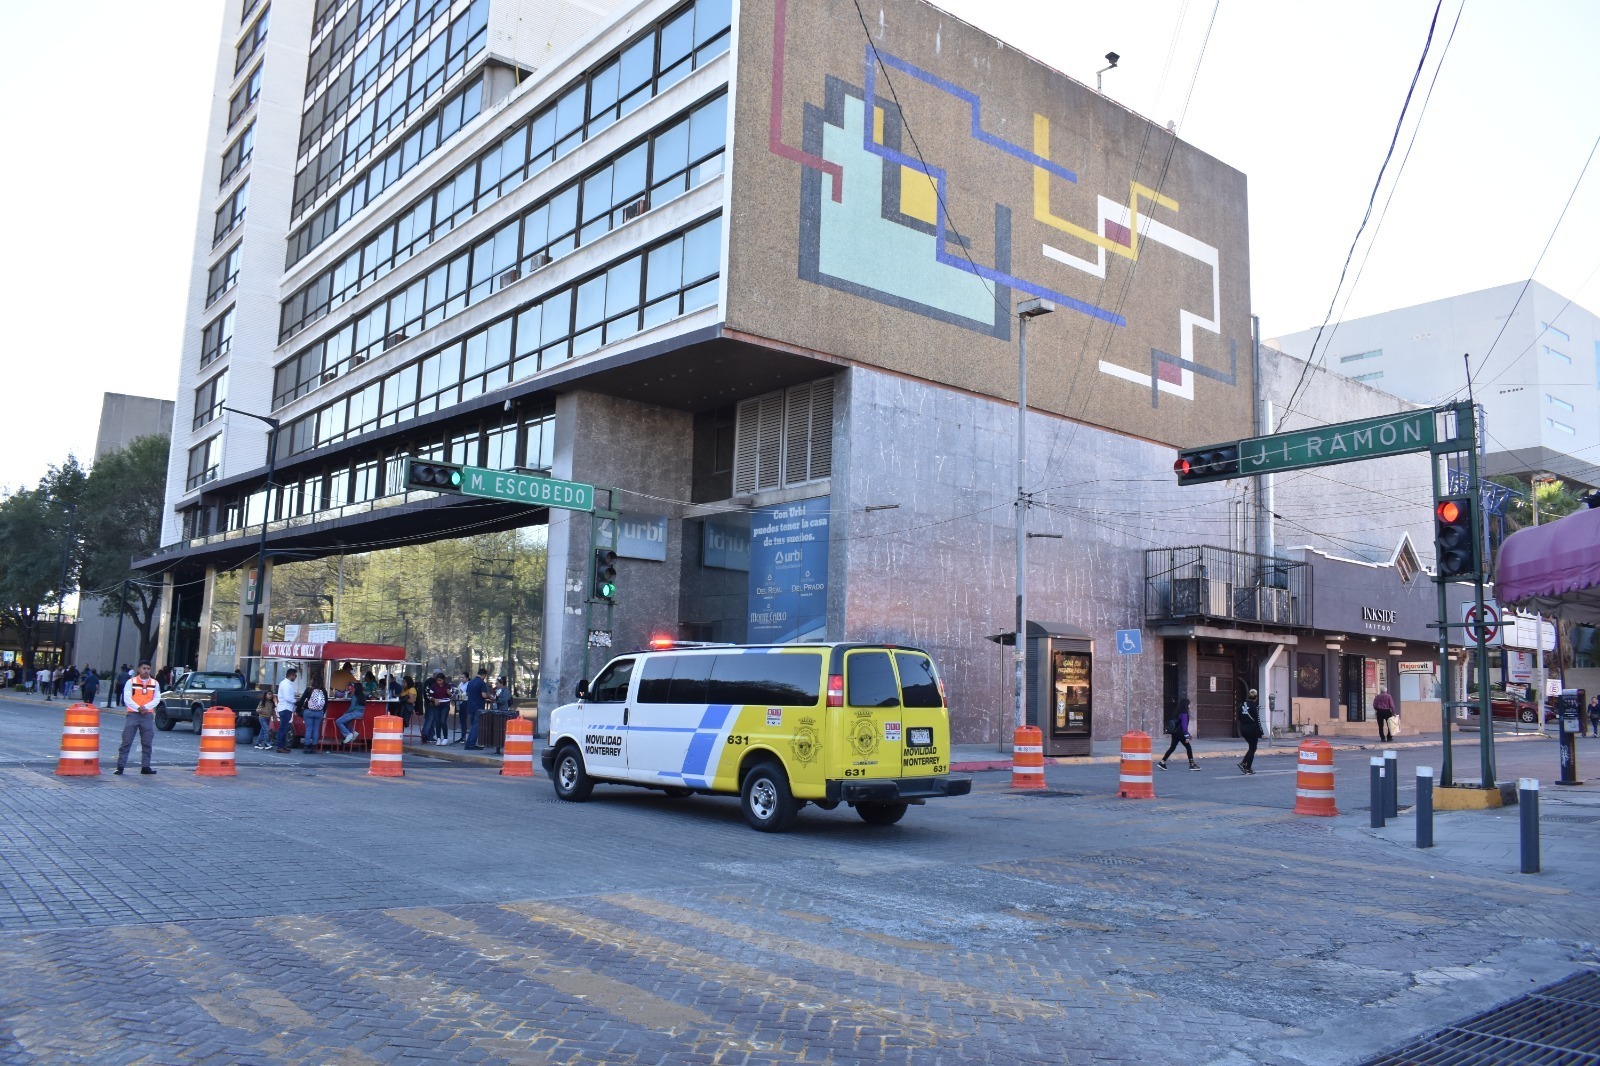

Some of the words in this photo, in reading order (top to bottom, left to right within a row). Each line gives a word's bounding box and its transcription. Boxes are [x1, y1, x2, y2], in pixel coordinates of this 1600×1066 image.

[1252, 444, 1270, 466] J.
[1283, 441, 1293, 462] I.
[1307, 419, 1421, 458] RAMON
[472, 473, 486, 491] M.
[495, 478, 585, 504] ESCOBEDO
[773, 509, 788, 519] Con
[789, 505, 806, 517] Urbi
[624, 521, 663, 543] urbi
[753, 523, 779, 537] puedes
[780, 521, 800, 532] tener
[801, 518, 809, 529] la
[809, 518, 828, 527] casa
[763, 536, 773, 547] de
[784, 548, 803, 563] urbi
[1362, 606, 1397, 624] INKSIDE
[1365, 622, 1391, 632] TATTOO
[1400, 662, 1429, 671] Mejoravit
[585, 734, 622, 746] MOVILIDAD
[727, 735, 749, 745] 631
[585, 745, 622, 757] MONTERREY
[903, 746, 937, 756] MOVILIDAD
[903, 756, 940, 766] MONTERREY
[844, 768, 866, 776] 631
[933, 765, 947, 773] 631
